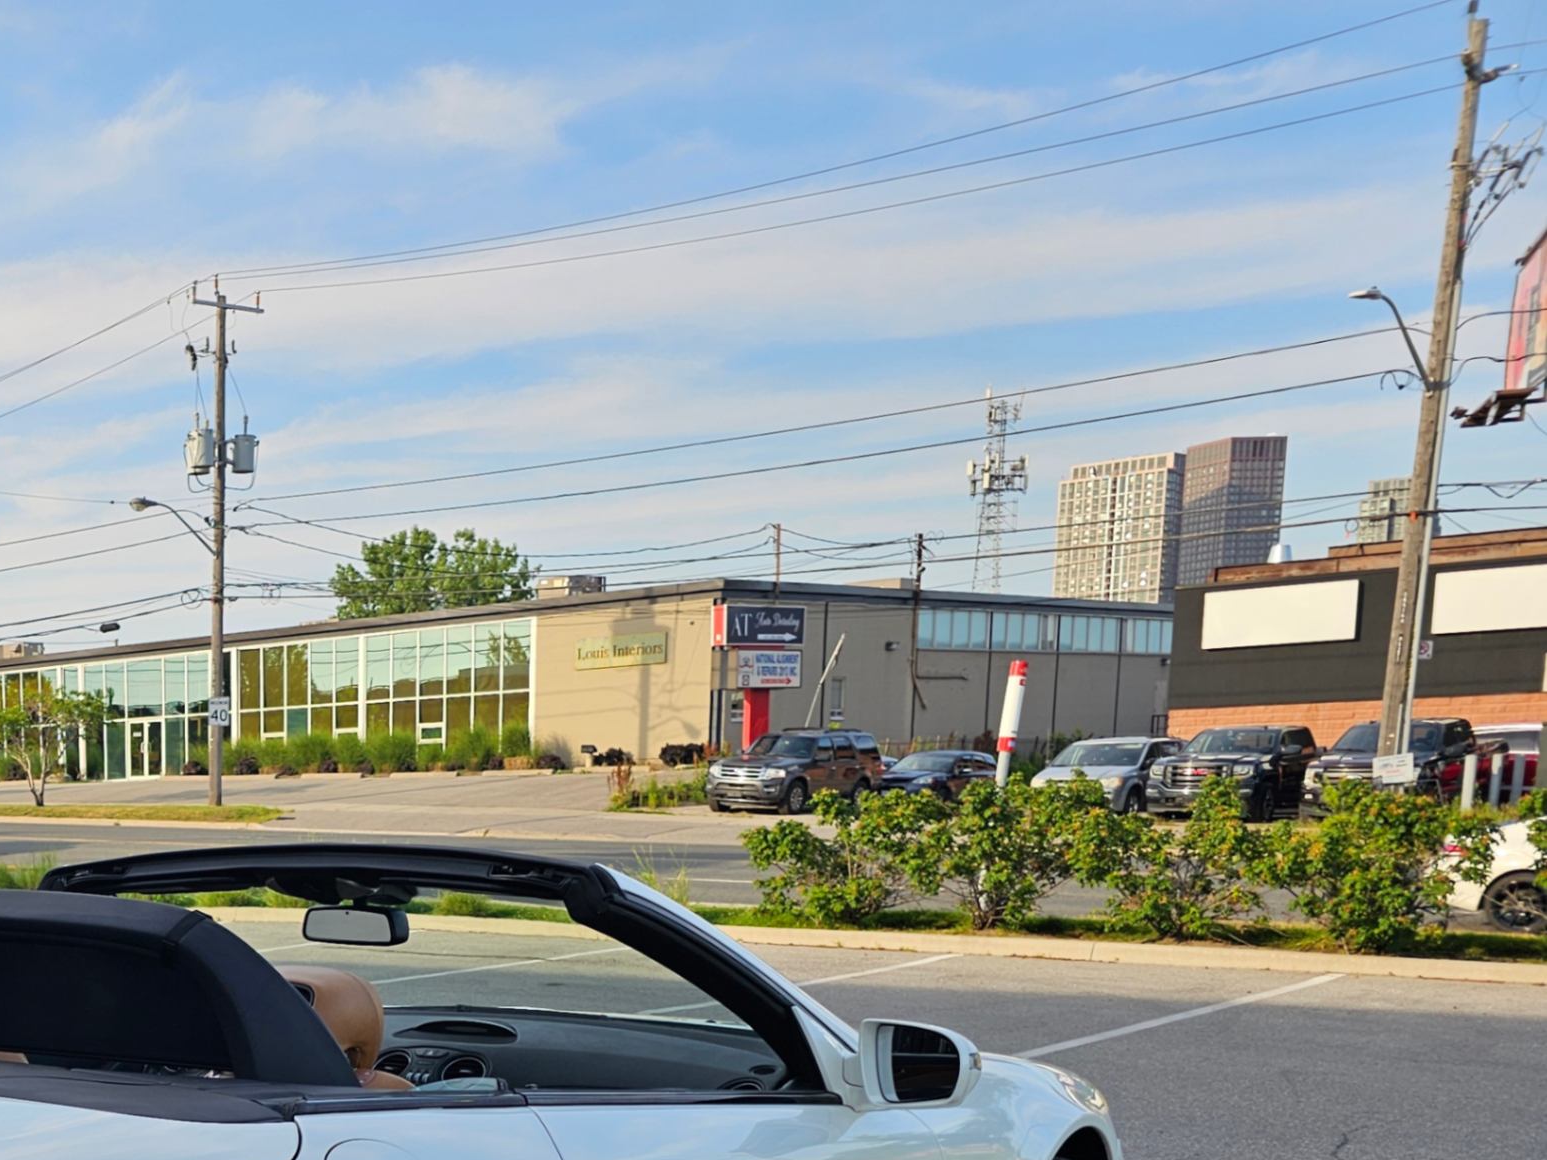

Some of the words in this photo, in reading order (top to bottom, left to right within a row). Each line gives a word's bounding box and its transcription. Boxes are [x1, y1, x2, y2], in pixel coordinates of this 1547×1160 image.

[731, 612, 753, 637] AT
[612, 642, 663, 657] Interiors
[210, 709, 228, 722] 40
